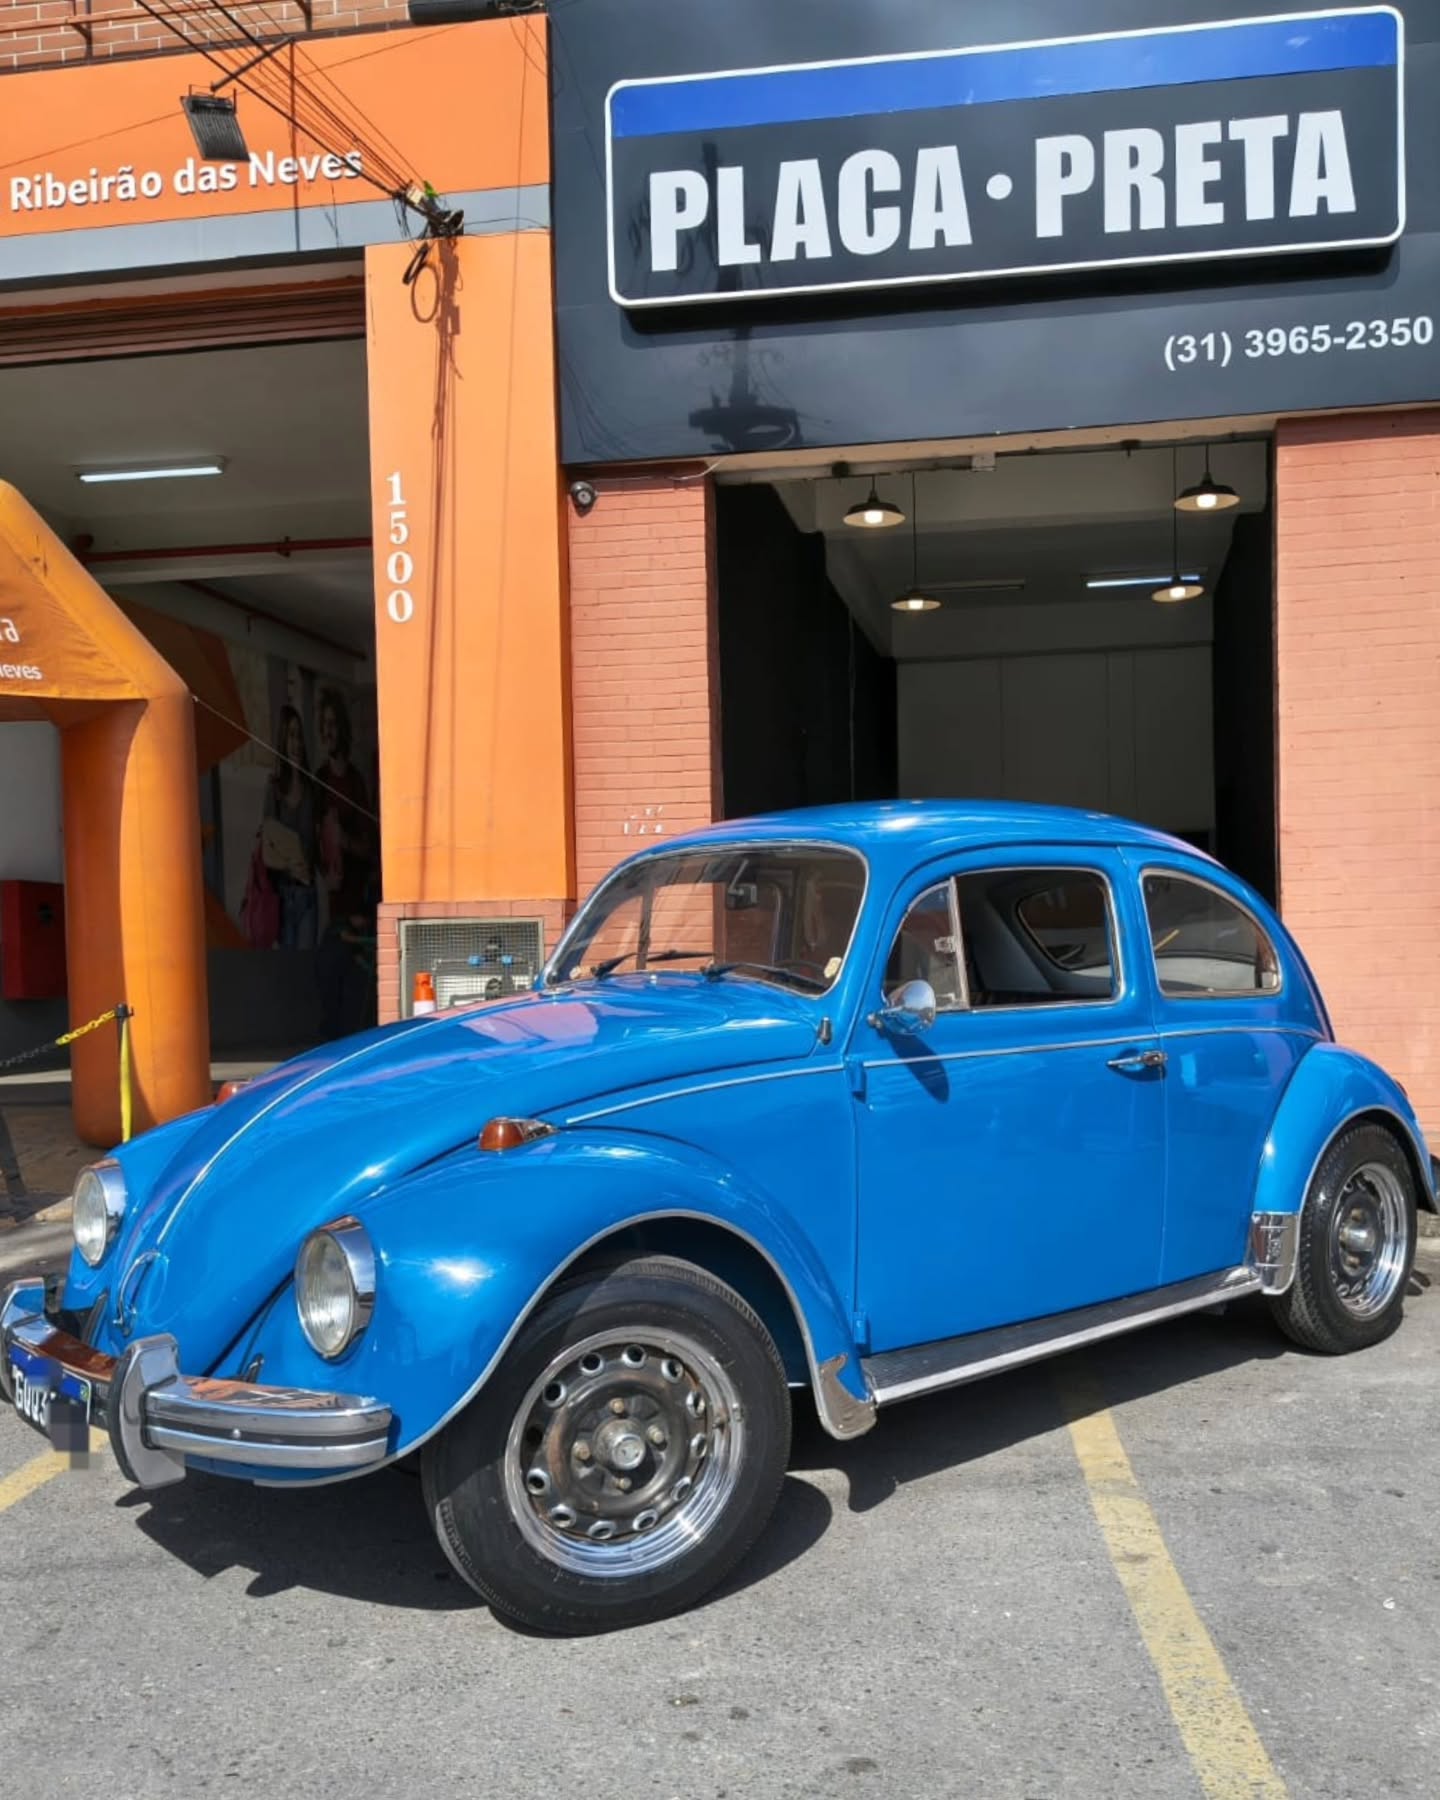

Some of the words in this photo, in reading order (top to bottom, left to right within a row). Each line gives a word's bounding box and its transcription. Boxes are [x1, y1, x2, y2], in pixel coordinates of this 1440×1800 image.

[10, 165, 163, 211] Ribeirão
[173, 157, 238, 194] das
[249, 150, 362, 187] Neves
[649, 145, 973, 272] PLACA
[1035, 110, 1357, 238] PRETA
[1164, 331, 1232, 371] (31)
[1244, 316, 1434, 358] 3965-2350
[386, 471, 413, 623] 1500
[0, 618, 20, 643] a
